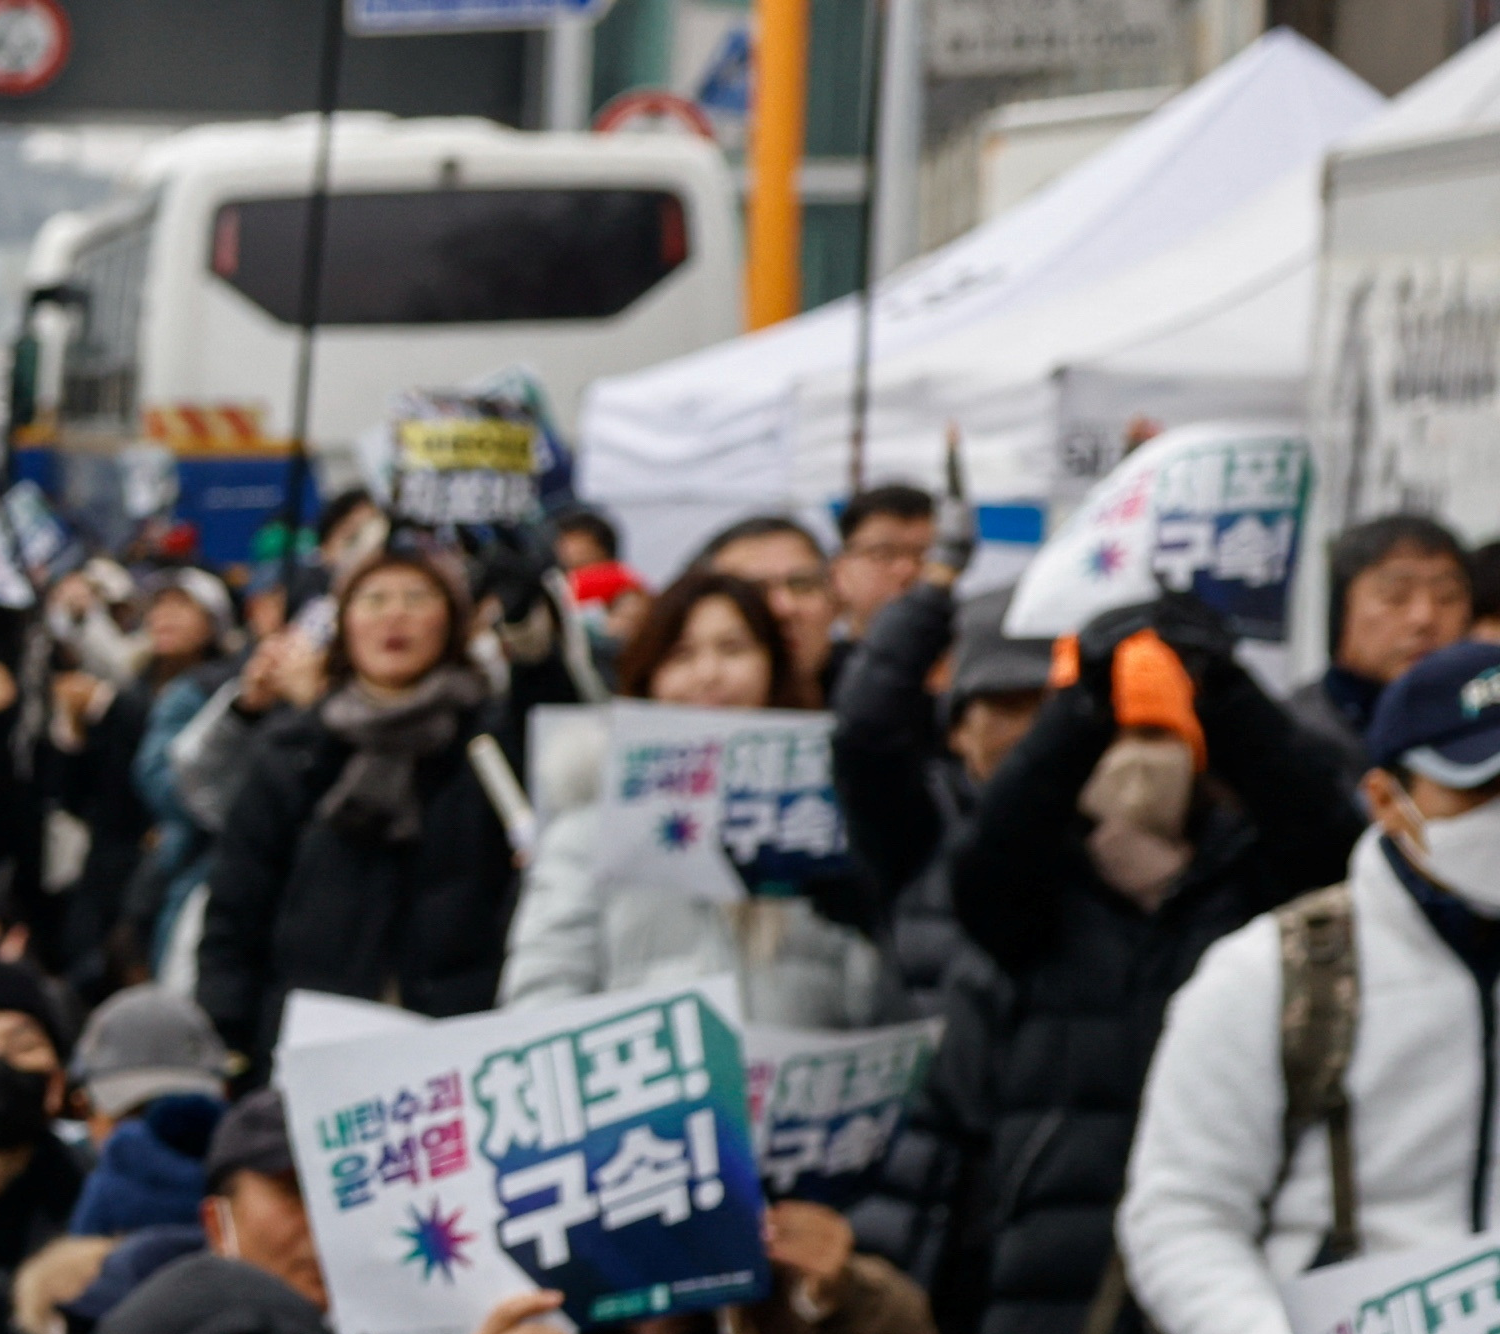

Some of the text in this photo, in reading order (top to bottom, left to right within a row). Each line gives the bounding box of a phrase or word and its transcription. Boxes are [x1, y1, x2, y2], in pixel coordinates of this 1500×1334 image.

[317, 1068, 462, 1152] 내란수괴
[477, 997, 709, 1157] 체포!
[326, 1118, 468, 1212] 윤석열
[500, 1107, 728, 1270] 구속!
